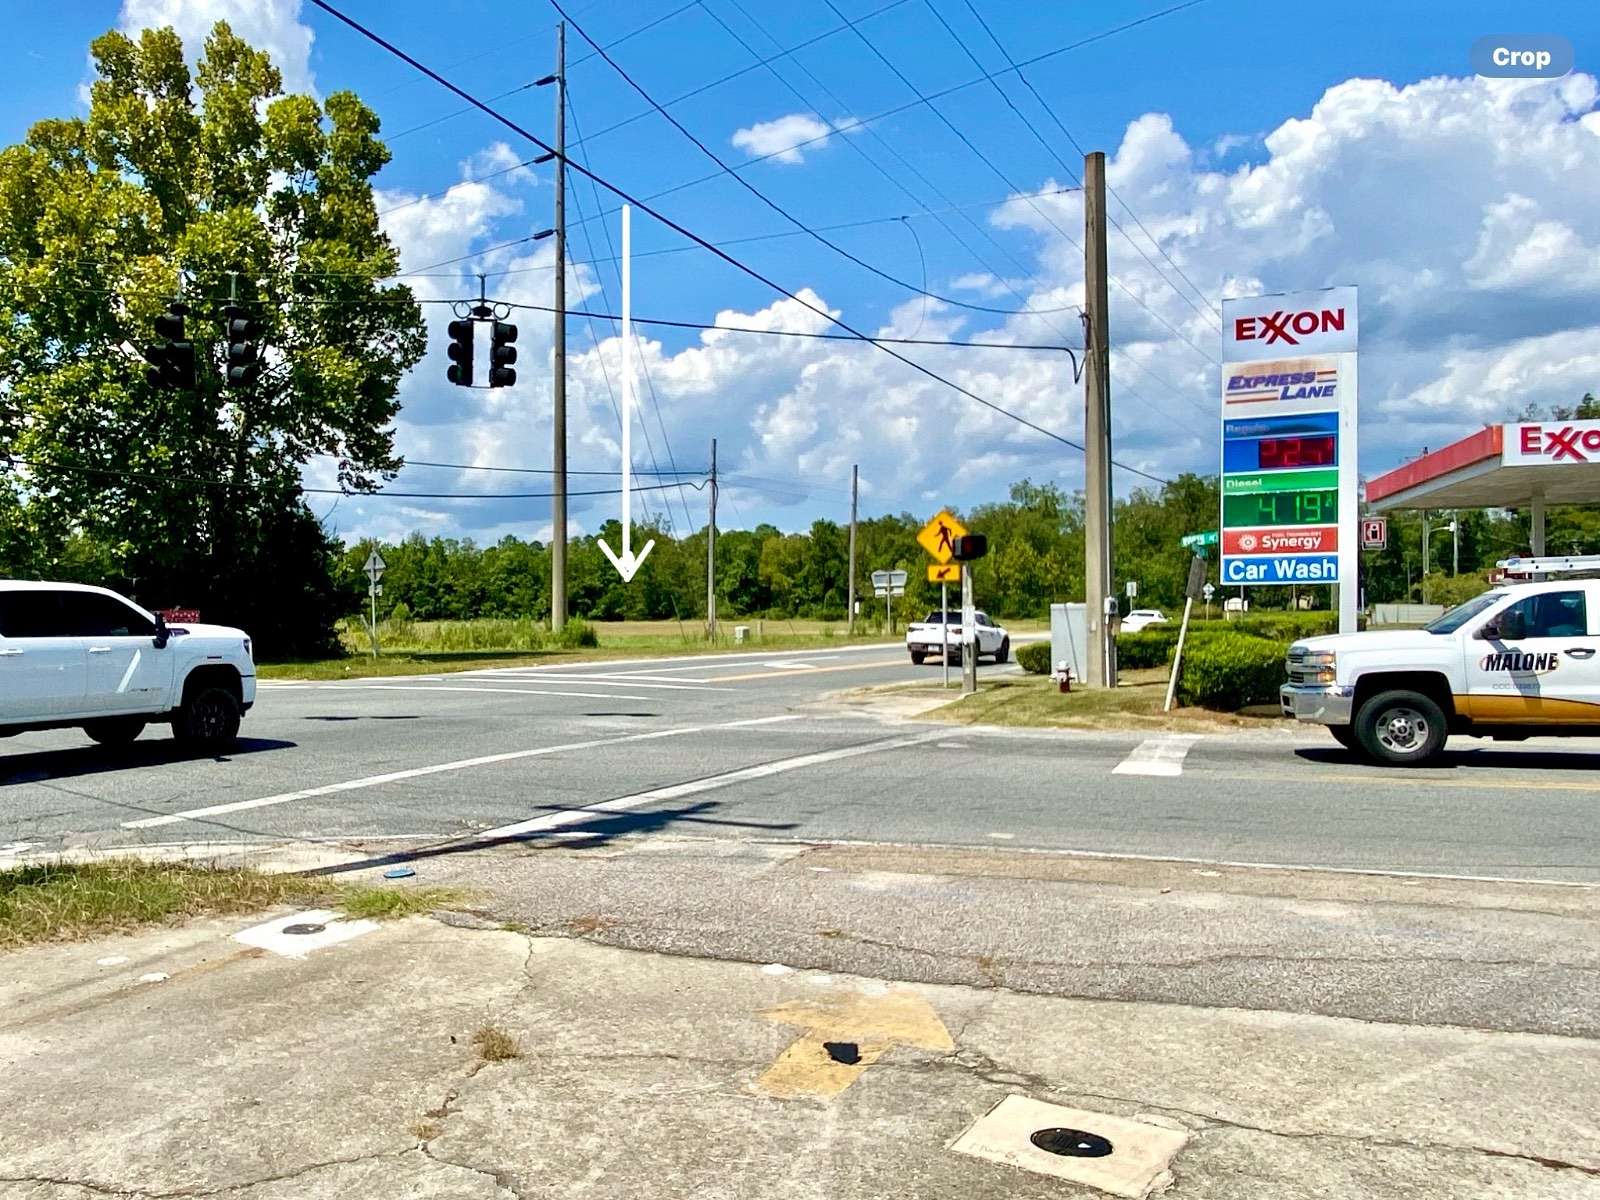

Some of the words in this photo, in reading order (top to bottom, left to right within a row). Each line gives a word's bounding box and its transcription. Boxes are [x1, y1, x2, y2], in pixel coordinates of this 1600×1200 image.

[1235, 308, 1345, 345] EXXON
[1227, 372, 1316, 391] EXPRESS
[1280, 385, 1336, 401] LANE
[1262, 535, 1322, 550] Synergy
[1228, 560, 1268, 580] Car
[1274, 559, 1337, 579] Wash
[1485, 653, 1559, 671] MALONE
